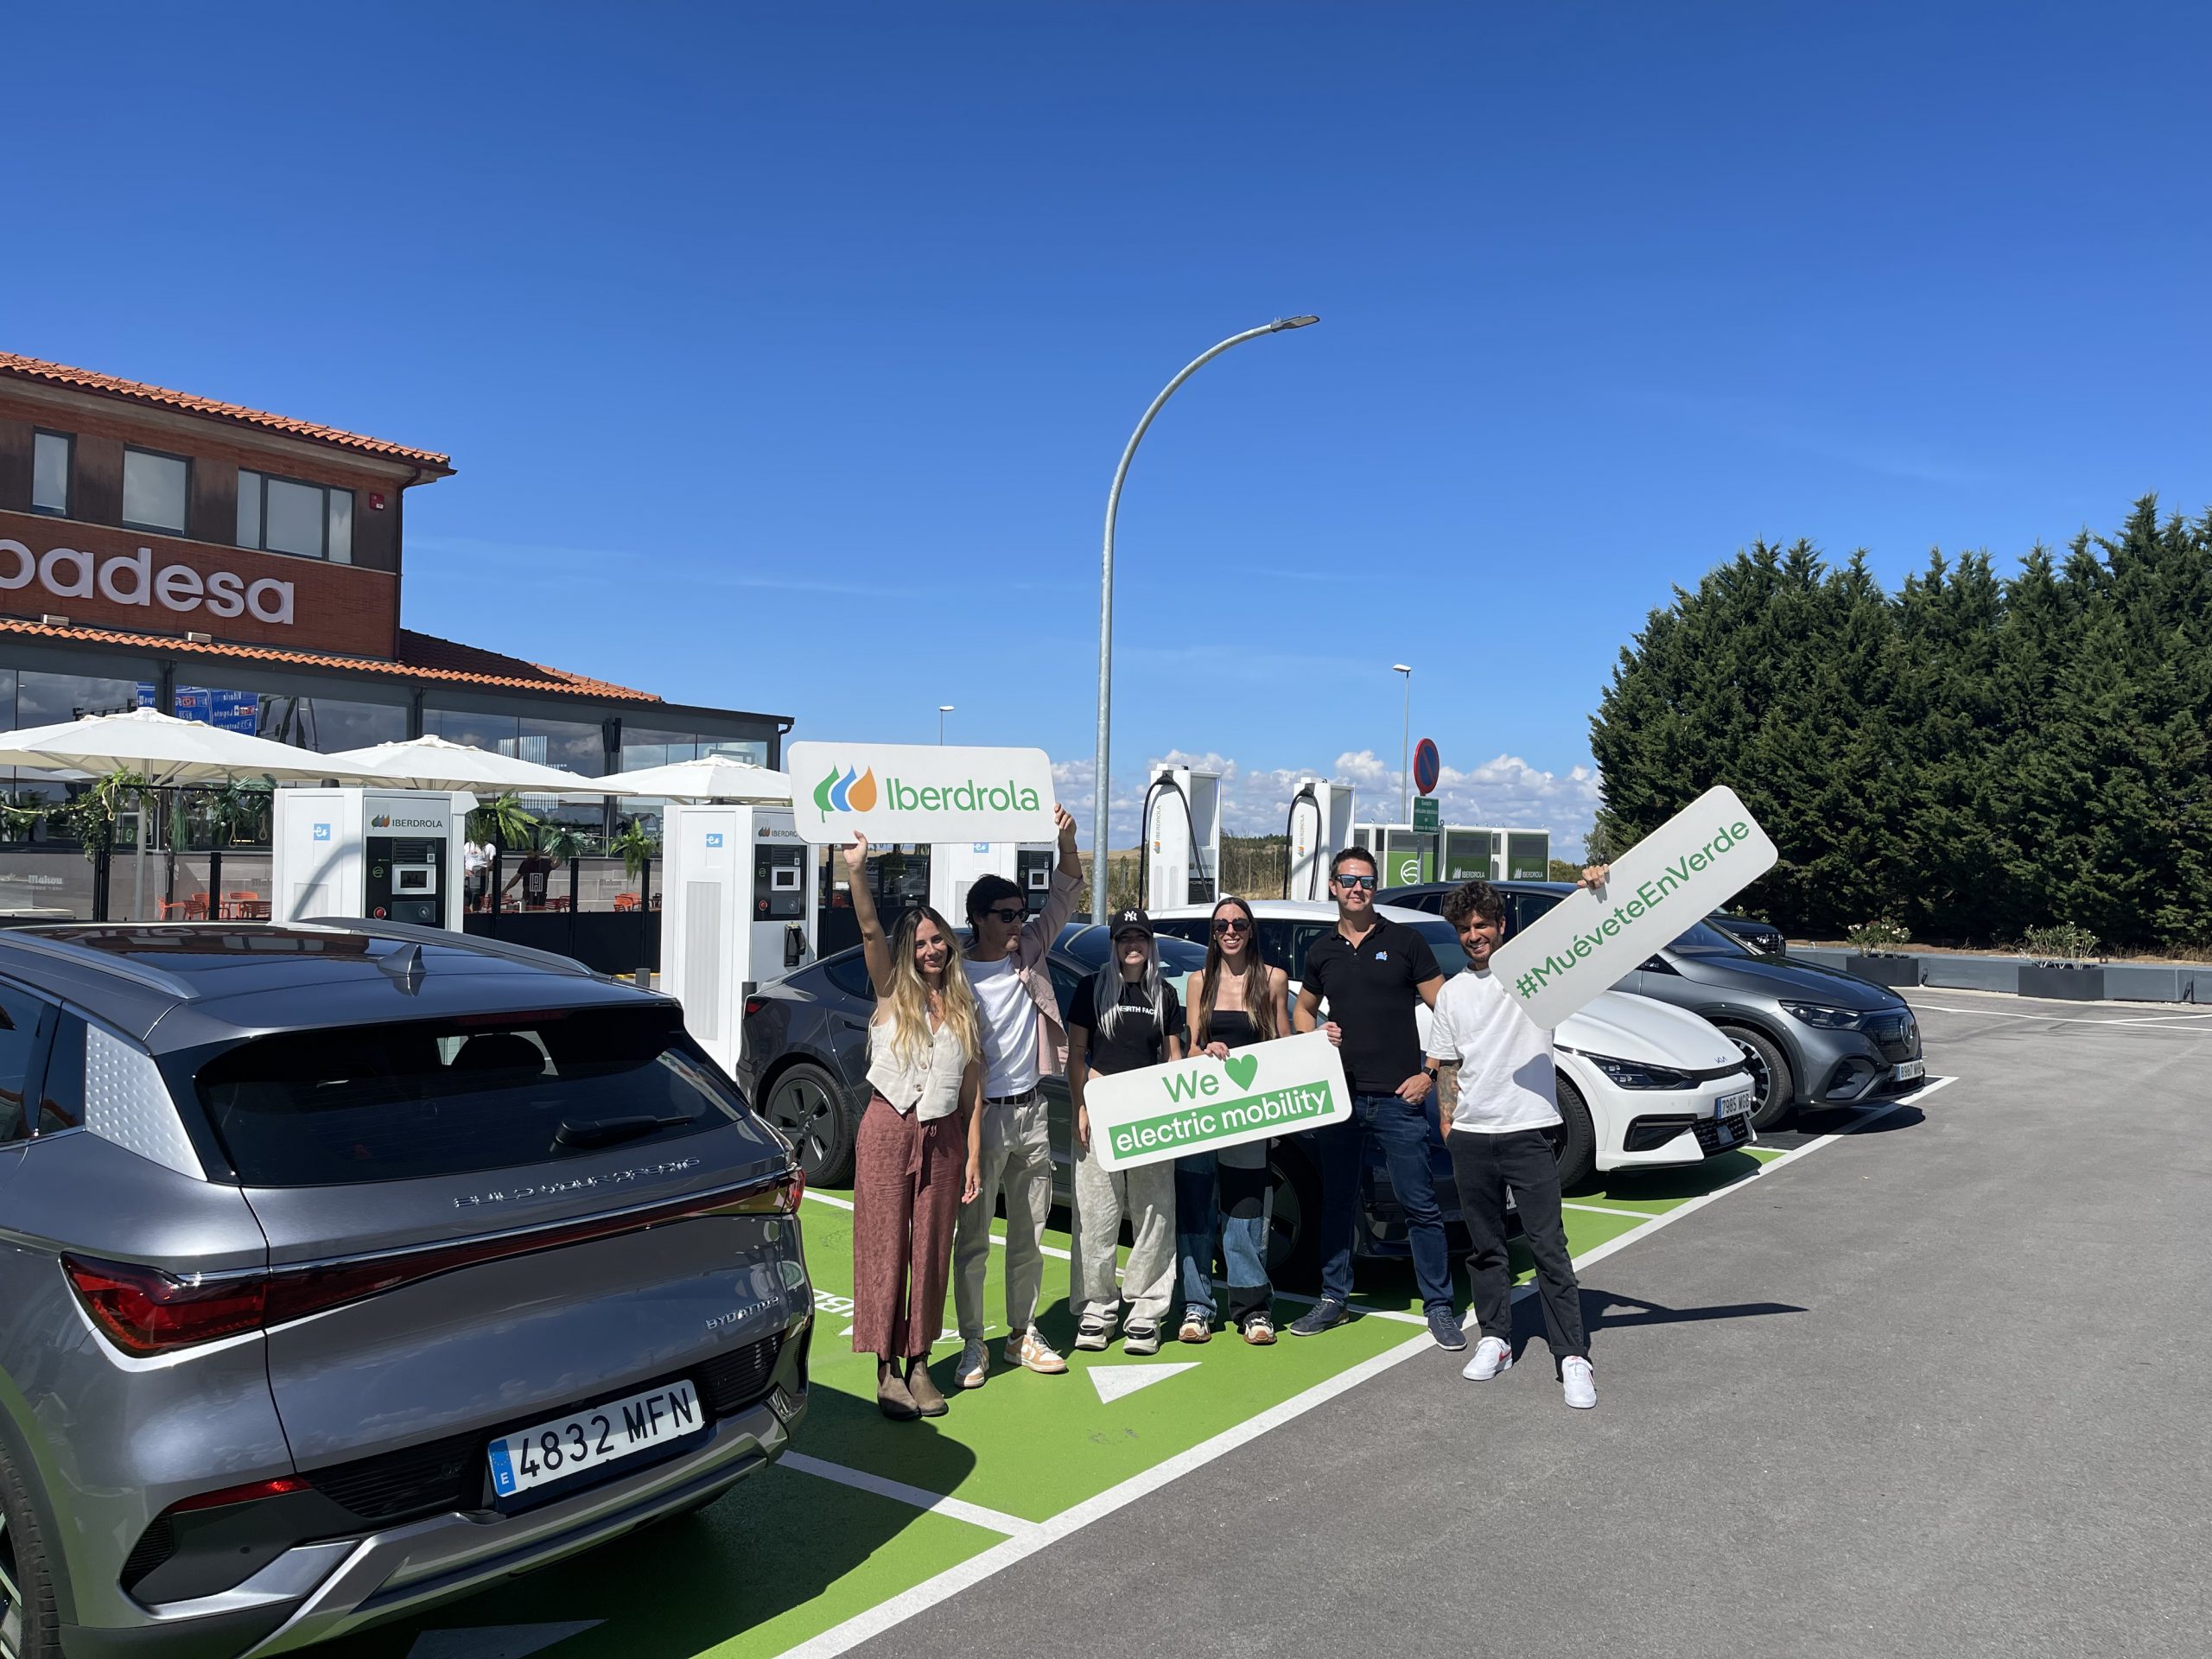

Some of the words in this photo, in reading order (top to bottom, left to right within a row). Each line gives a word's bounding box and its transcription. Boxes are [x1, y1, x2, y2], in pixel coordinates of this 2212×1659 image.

[887, 778, 1039, 812] Iberdrola
[392, 819, 442, 828] IBERDROLA
[1516, 821, 1750, 1000] #MuéveteEnVerde
[1142, 1007, 1156, 1015] FAC
[1161, 1070, 1219, 1103] We
[1116, 1112, 1217, 1153] electric
[1222, 1089, 1327, 1129] mobility
[1722, 1098, 1737, 1115] 7985
[540, 1175, 611, 1194] YOUR
[501, 1471, 510, 1484] E
[520, 1414, 614, 1478] 4832
[622, 1388, 693, 1443] MFN
